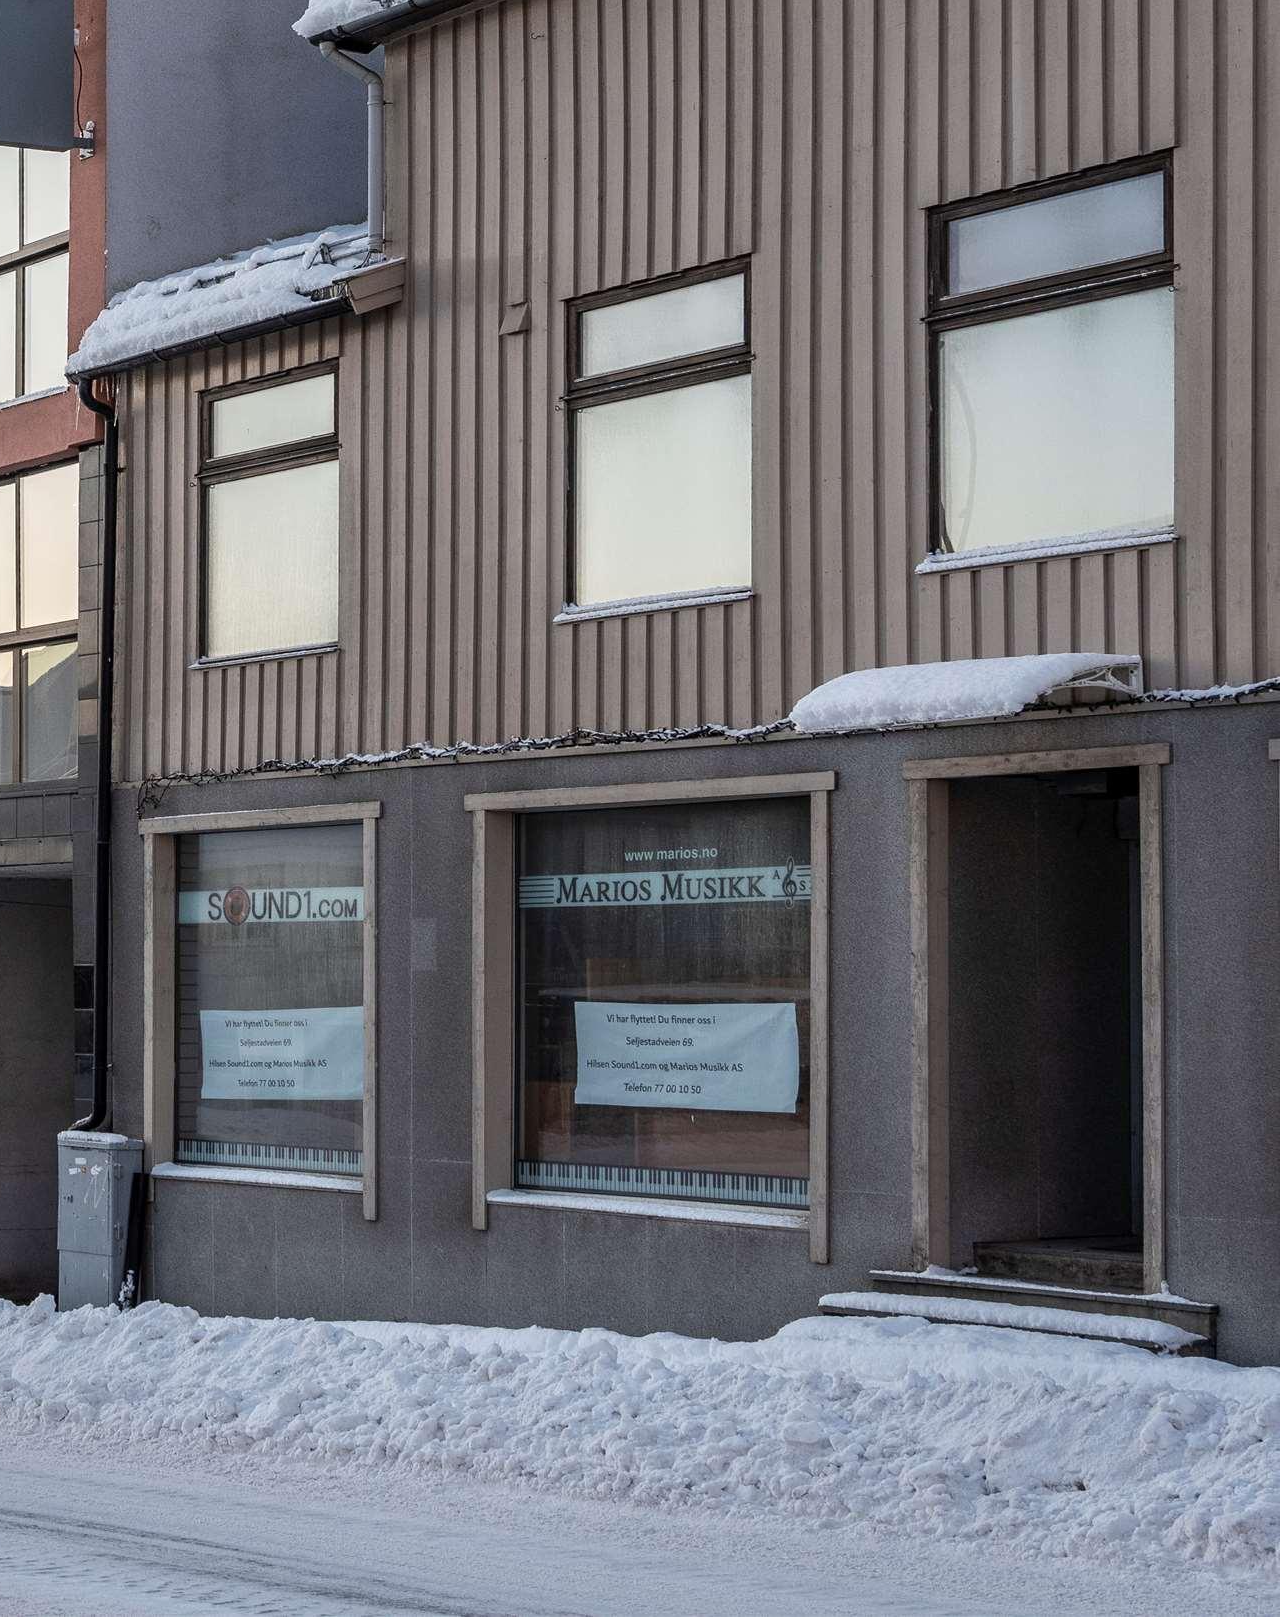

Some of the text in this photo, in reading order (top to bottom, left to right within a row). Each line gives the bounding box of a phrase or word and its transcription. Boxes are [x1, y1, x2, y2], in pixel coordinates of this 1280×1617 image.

[660, 873, 766, 902] MUSIKK
[606, 1014, 615, 1023] Vi
[616, 1014, 629, 1023] har
[658, 1015, 670, 1024] Du
[671, 1015, 695, 1024] finner
[697, 1017, 711, 1025] oss
[625, 1036, 681, 1048] Seljestadveien
[317, 1059, 328, 1068] AS
[586, 1059, 610, 1069] Hilsen
[658, 1063, 669, 1072] og
[670, 1062, 698, 1072] Marios
[700, 1063, 730, 1072] Musikk
[731, 1063, 744, 1072] AS
[624, 1083, 702, 1094] Telefon 77 00 10 50
